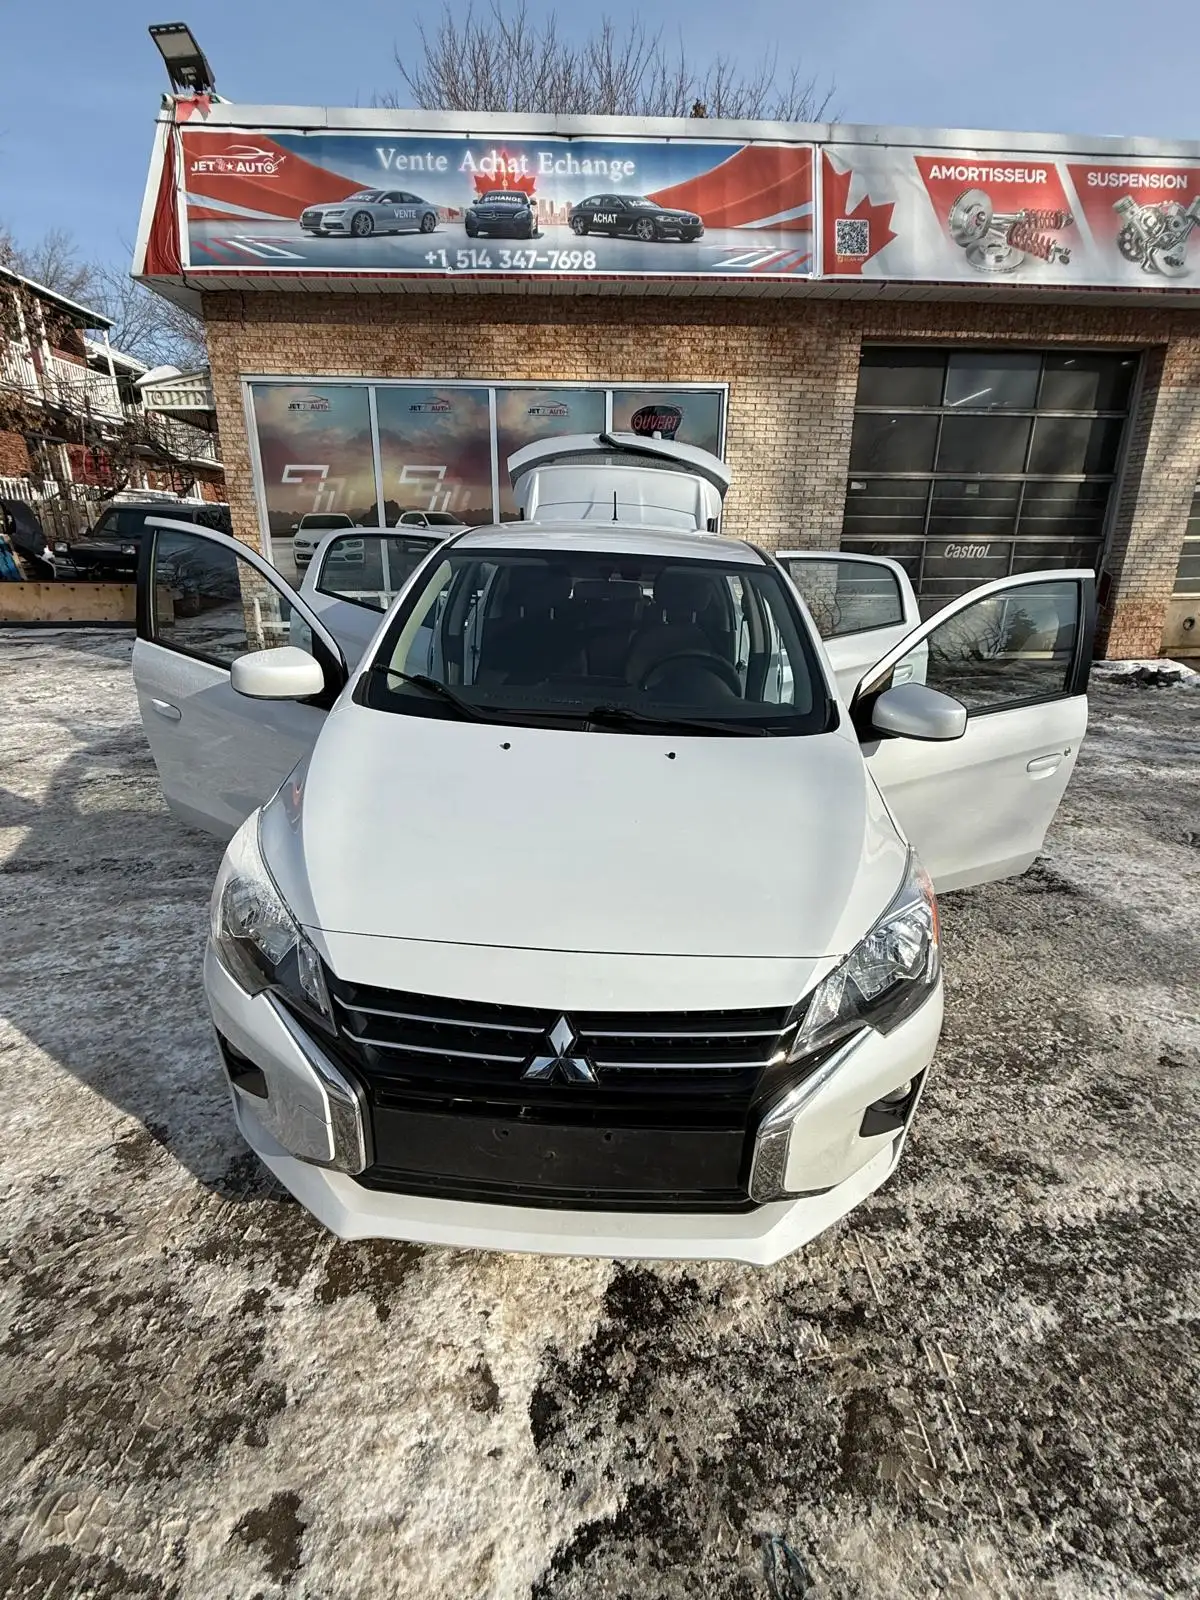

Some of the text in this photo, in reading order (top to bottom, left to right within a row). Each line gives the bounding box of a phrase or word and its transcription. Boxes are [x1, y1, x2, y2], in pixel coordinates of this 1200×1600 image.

[190, 161, 275, 174] JET AUTO
[375, 147, 635, 182] Vente Achat Echange
[928, 164, 1048, 184] AMORTISSEUR
[1087, 171, 1188, 189] SUSPENSION
[393, 208, 417, 219] VENTE
[592, 212, 617, 224] ACHAT
[424, 248, 597, 270] +1 514 347-7698
[633, 414, 678, 431] OUVERT
[944, 543, 991, 559] Castrol
